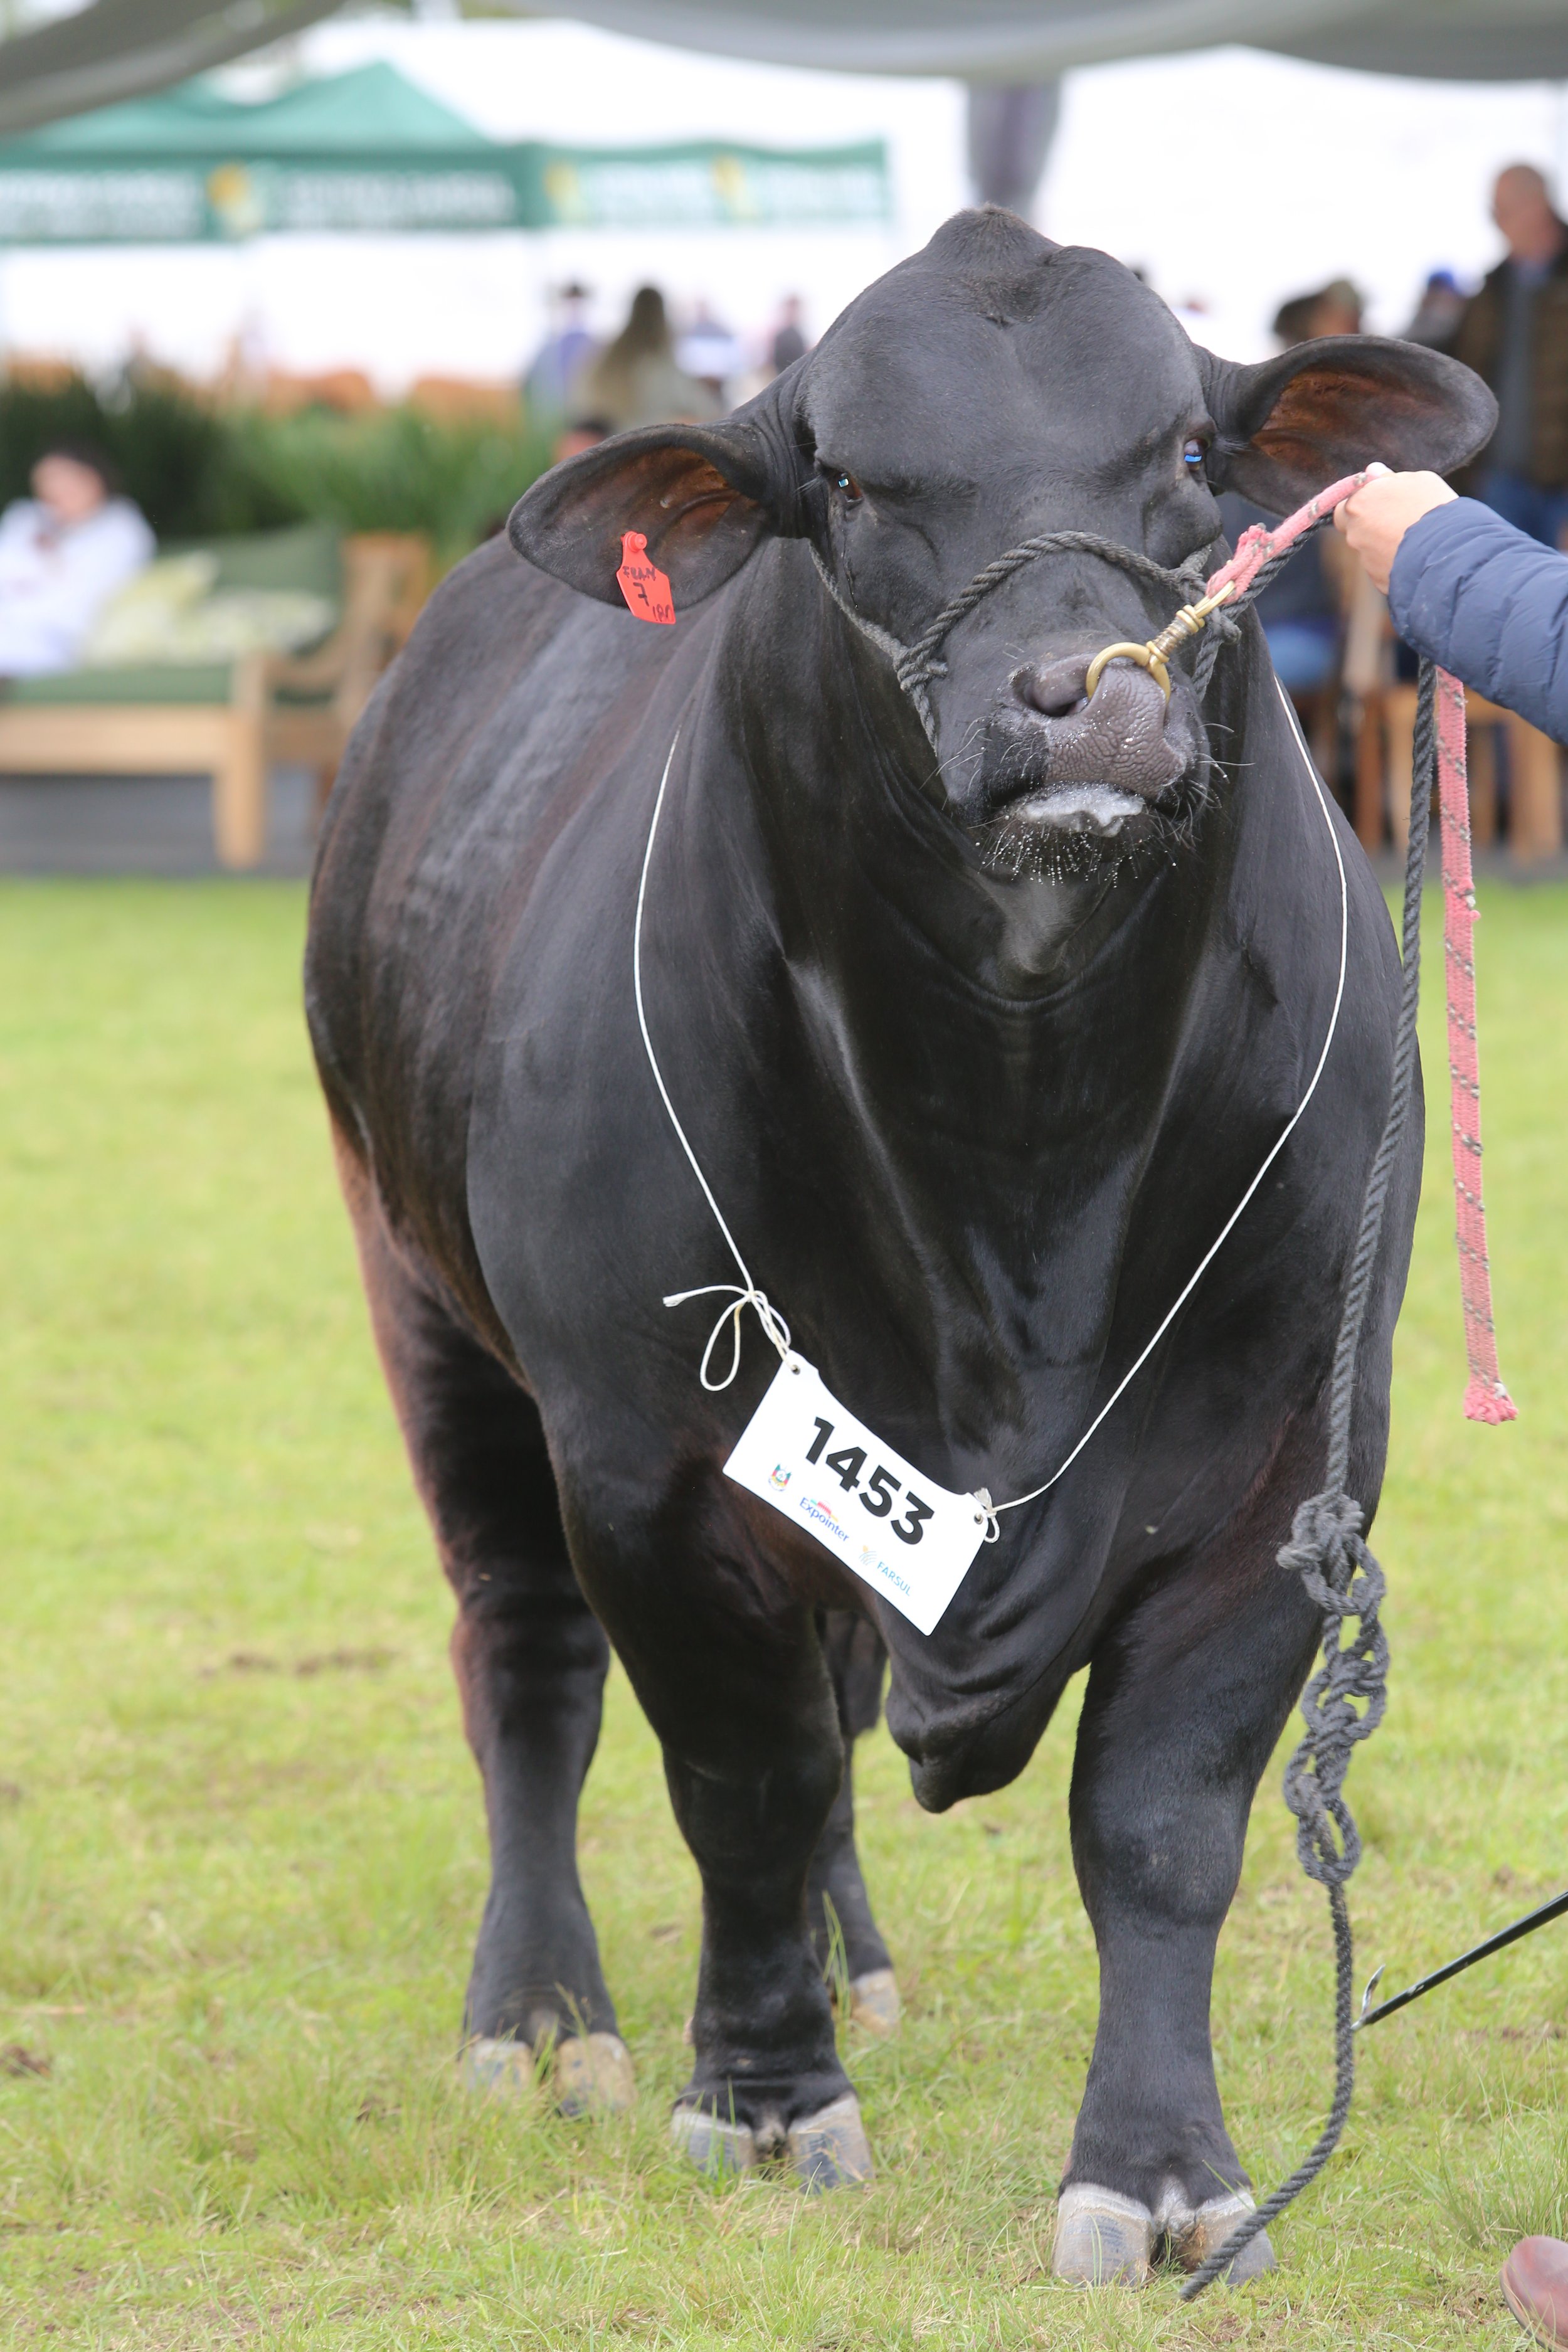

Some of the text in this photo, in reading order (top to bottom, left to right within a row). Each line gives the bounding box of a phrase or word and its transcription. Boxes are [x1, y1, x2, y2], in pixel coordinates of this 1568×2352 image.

[633, 582, 649, 607] 7
[805, 1416, 935, 1545] 1453
[799, 1496, 849, 1542] Expointer
[877, 1561, 911, 1597] FARSUL
